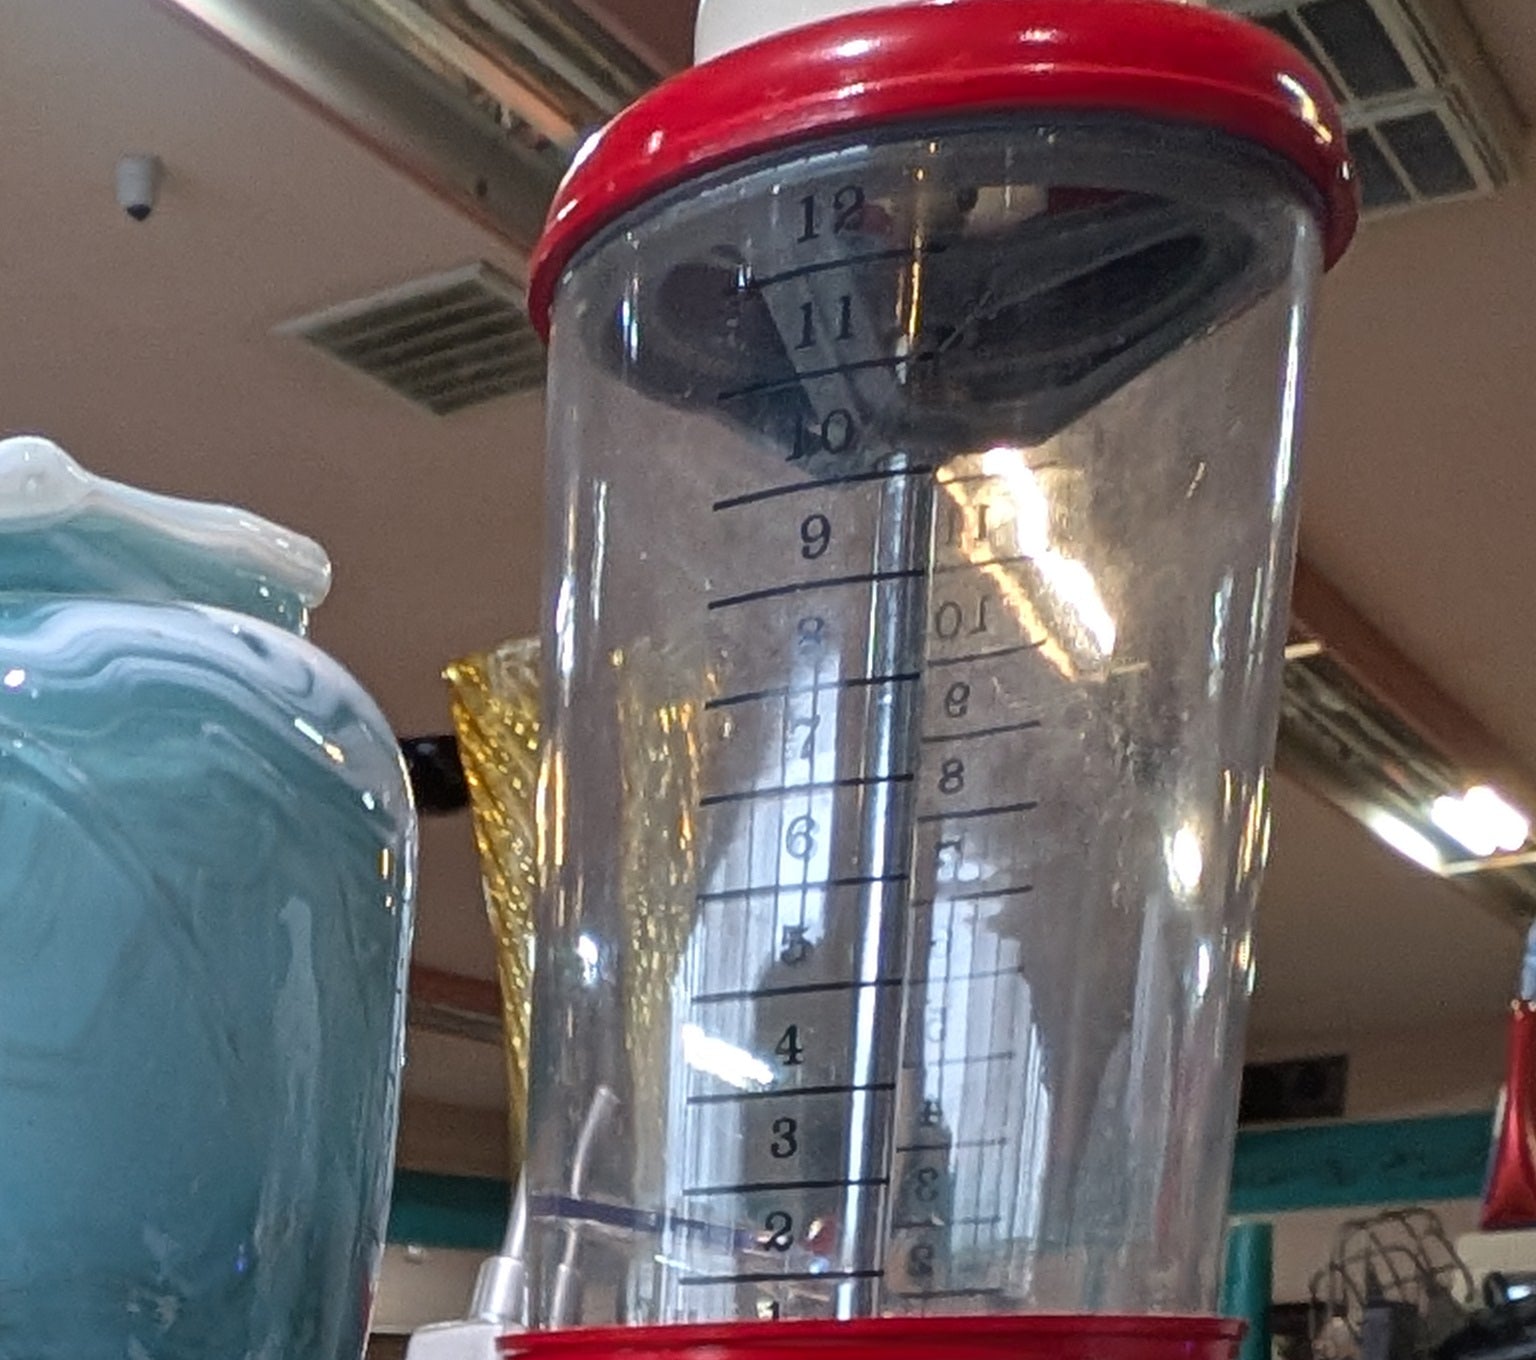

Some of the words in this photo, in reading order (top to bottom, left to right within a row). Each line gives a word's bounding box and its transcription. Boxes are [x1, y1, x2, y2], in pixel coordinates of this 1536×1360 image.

[797, 185, 866, 243] 12
[795, 295, 853, 349] 11
[784, 408, 853, 461] 10
[800, 513, 831, 560] 9
[790, 714, 821, 759] 7
[785, 815, 818, 860] 6
[780, 924, 813, 965] 5
[774, 1023, 804, 1066] 4
[770, 1116, 797, 1158] 3
[765, 1211, 794, 1252] 2
